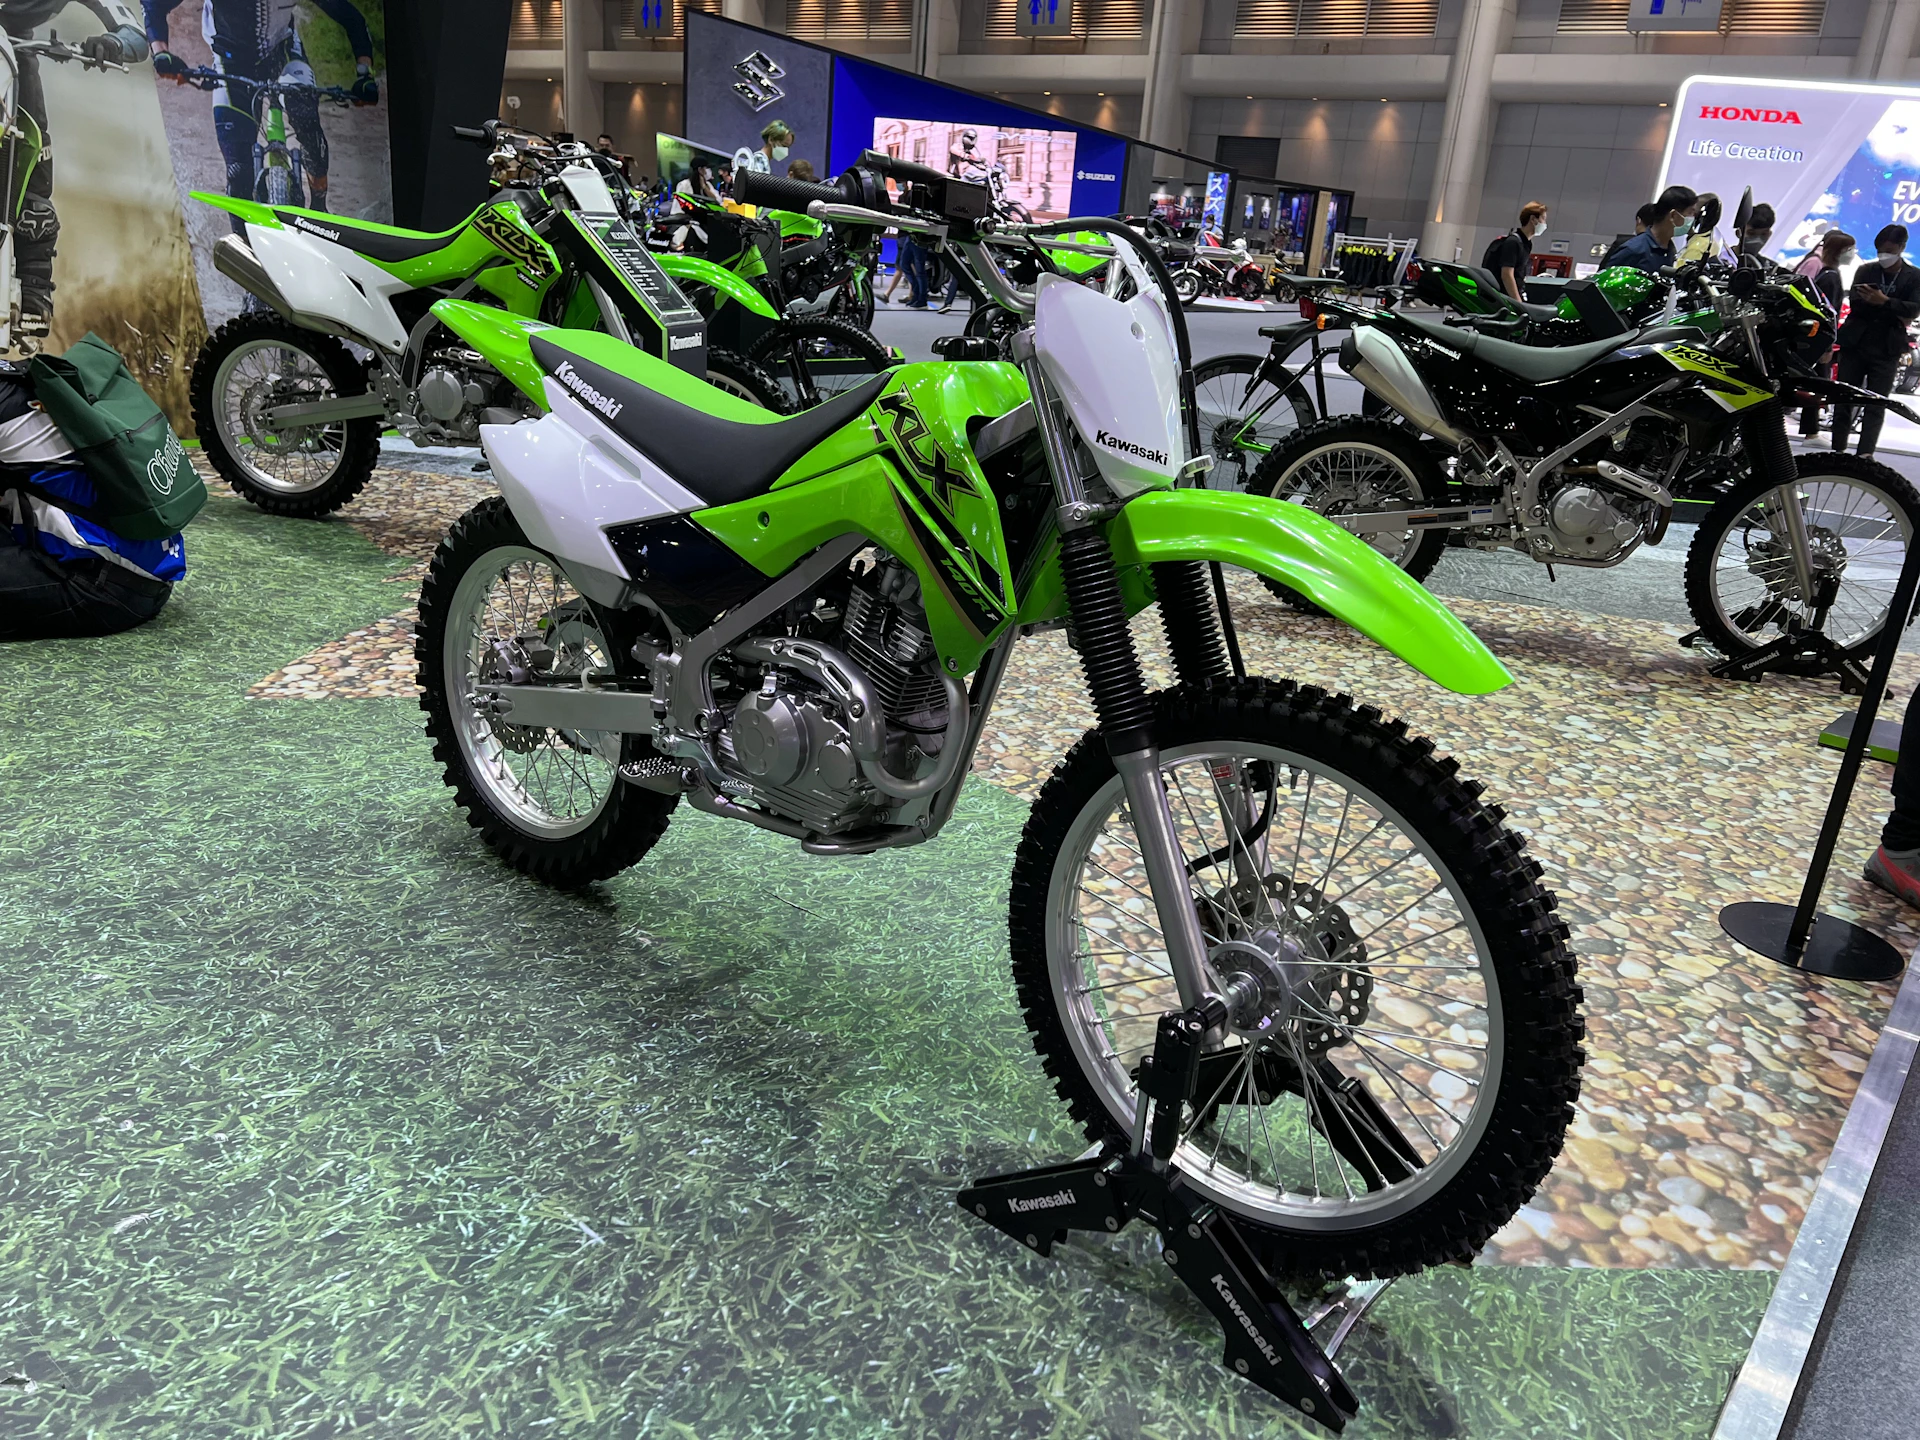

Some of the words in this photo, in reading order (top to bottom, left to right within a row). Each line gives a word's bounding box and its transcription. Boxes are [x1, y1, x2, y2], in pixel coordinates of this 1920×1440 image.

[1699, 106, 1803, 125] HONDA
[1690, 140, 1722, 157] Life
[1727, 142, 1804, 163] Creation
[1084, 172, 1116, 182] SUZUKI
[294, 216, 340, 241] Kawasaki
[475, 207, 550, 275] KLX
[669, 332, 703, 351] Kawasaki
[1423, 337, 1462, 360] Kawasaki
[1666, 344, 1740, 375] KLX
[554, 360, 624, 420] Kawasaki
[875, 382, 983, 517] KLX
[1095, 429, 1169, 467] Kawasaki
[1741, 650, 1780, 671] Kawasaki
[1842, 658, 1869, 685] Kawasak
[1007, 1189, 1077, 1214] Kawasaki
[1210, 1273, 1282, 1367] Kawasaki
